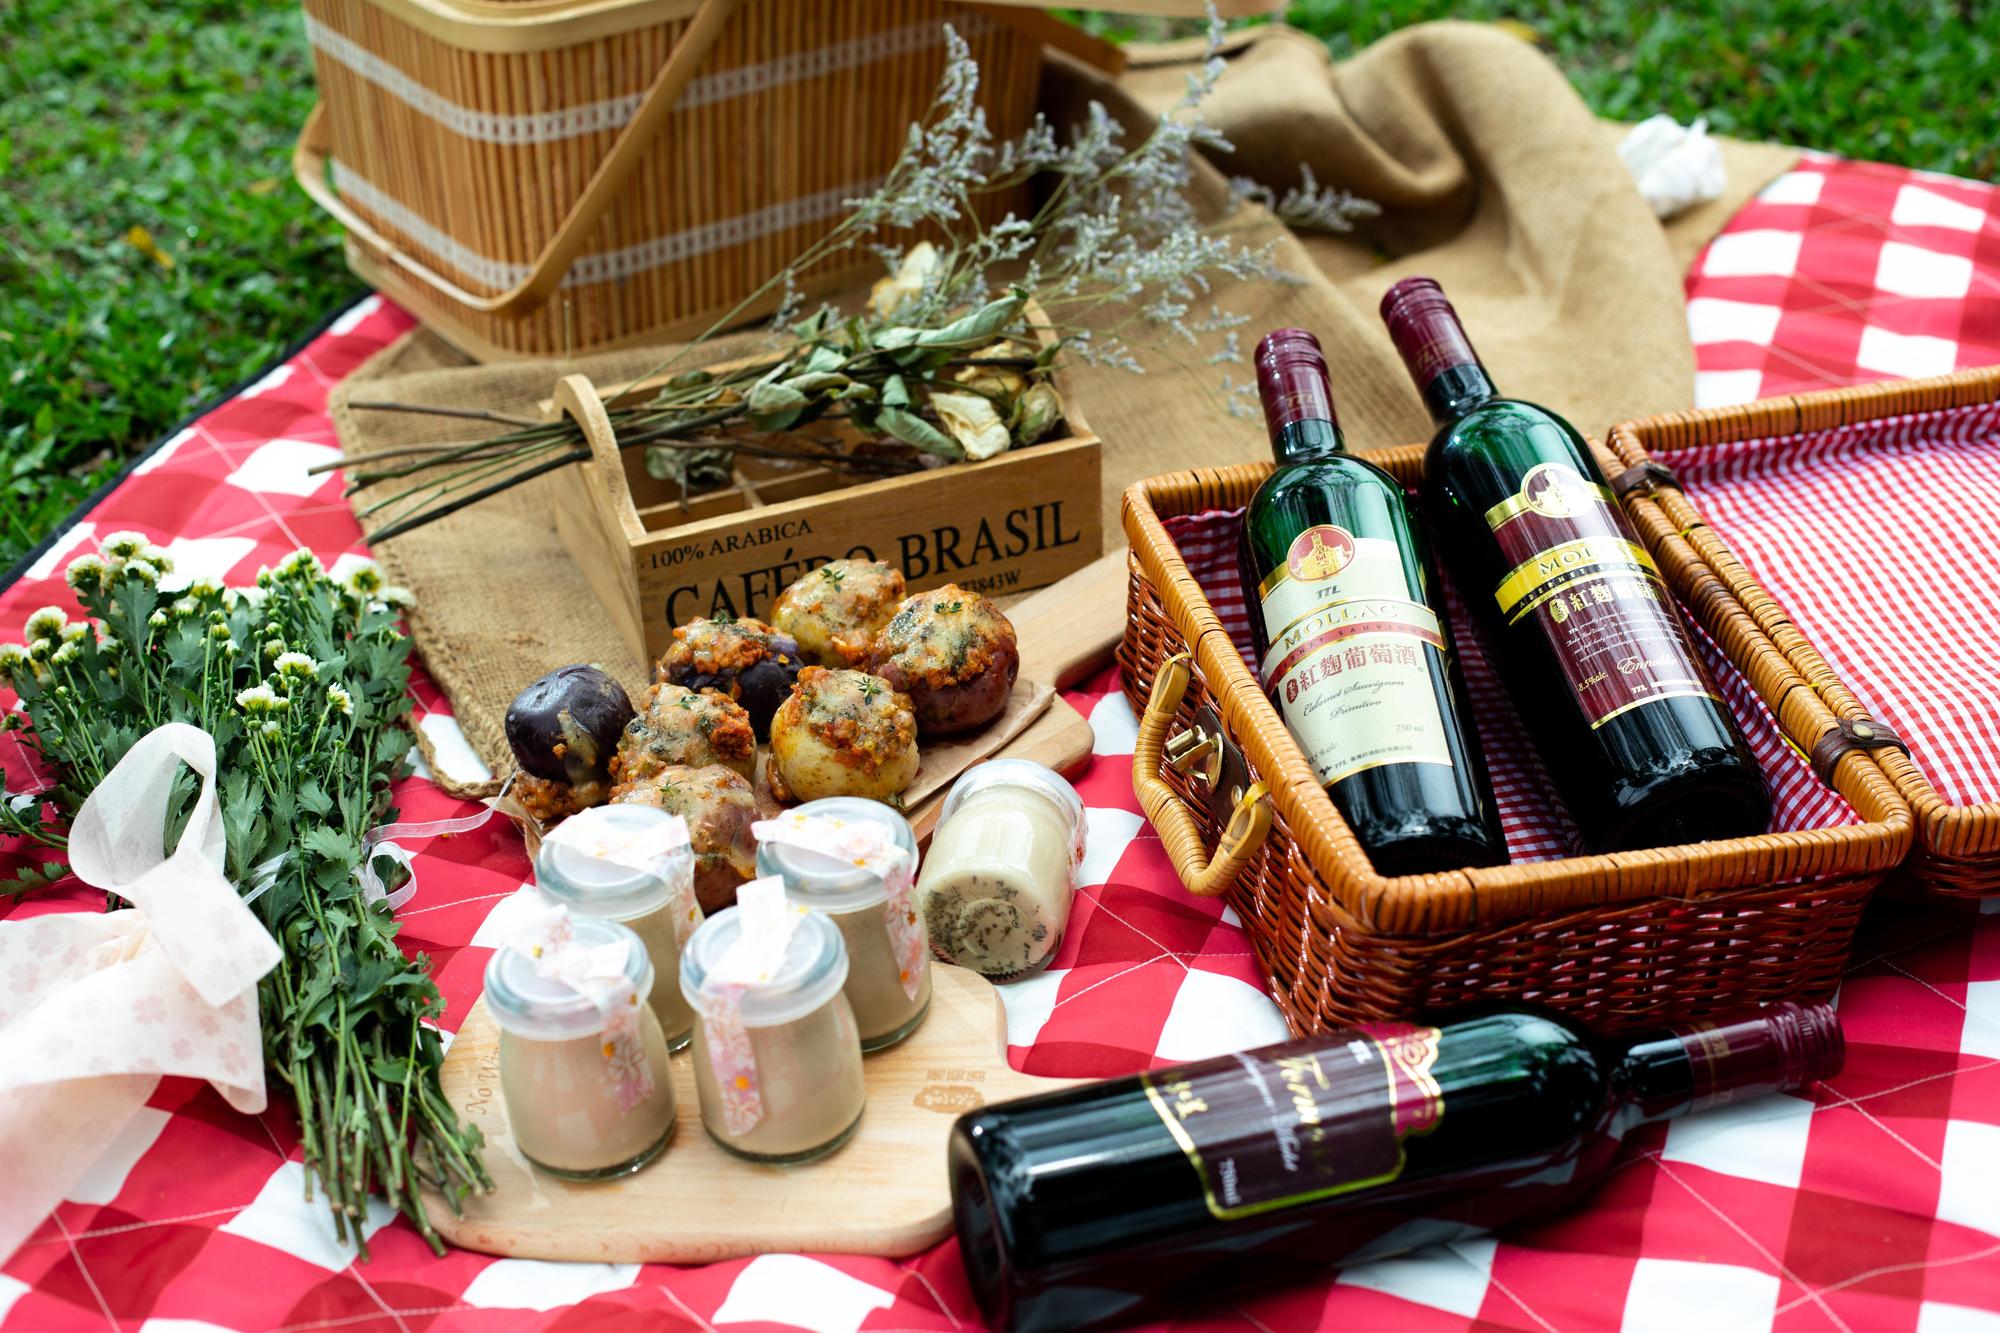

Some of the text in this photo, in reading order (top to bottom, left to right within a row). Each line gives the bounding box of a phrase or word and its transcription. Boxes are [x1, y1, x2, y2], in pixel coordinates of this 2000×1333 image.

[651, 519, 813, 569] 100% ARABICA
[897, 501, 1081, 583] BRASIL
[1315, 584, 1341, 600] TTL
[1344, 680, 1404, 697] Sauvignon
